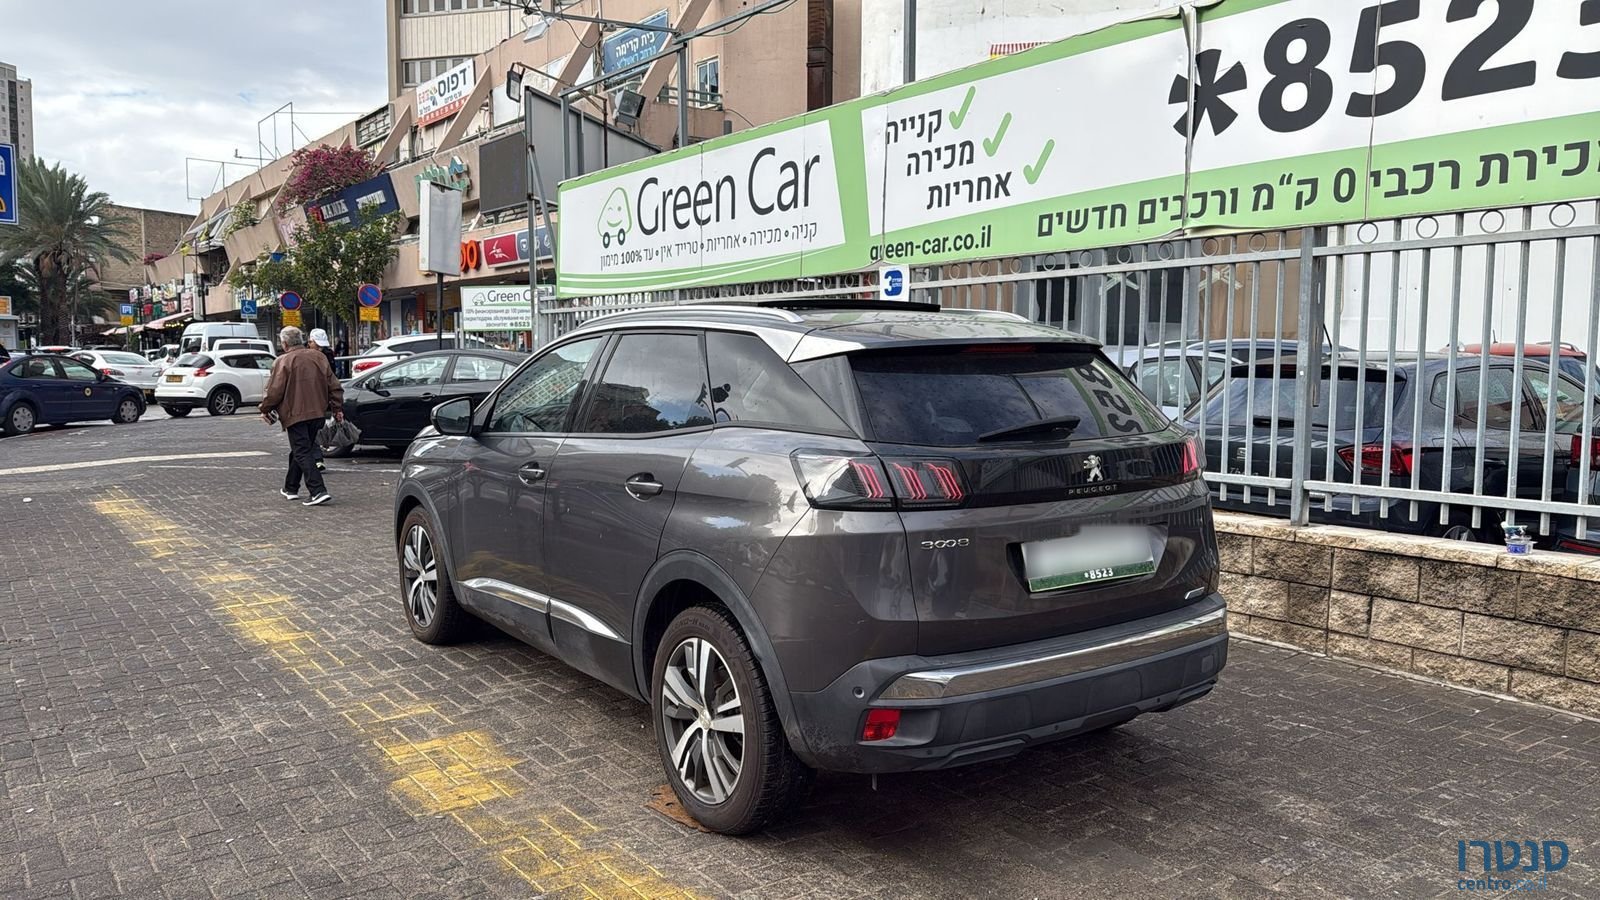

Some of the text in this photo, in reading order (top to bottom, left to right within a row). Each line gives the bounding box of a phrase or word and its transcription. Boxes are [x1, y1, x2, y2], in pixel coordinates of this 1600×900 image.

[437, 68, 468, 97] דפוס
[886, 109, 943, 145] קנייה
[906, 140, 975, 176] מכירה
[637, 146, 821, 236] Green Car
[926, 171, 1012, 210] אחריות
[1333, 167, 1357, 203] 0
[1370, 159, 1461, 198] רכבי
[1037, 203, 1127, 238] חדשים
[1138, 187, 1239, 225] ורכבים
[600, 221, 818, 271] קניה מכירה אחריות טרייד אין עד 100% מימון
[487, 289, 521, 303] Green
[1068, 484, 1118, 496] PEUGEOT
[920, 537, 970, 550] 3008
